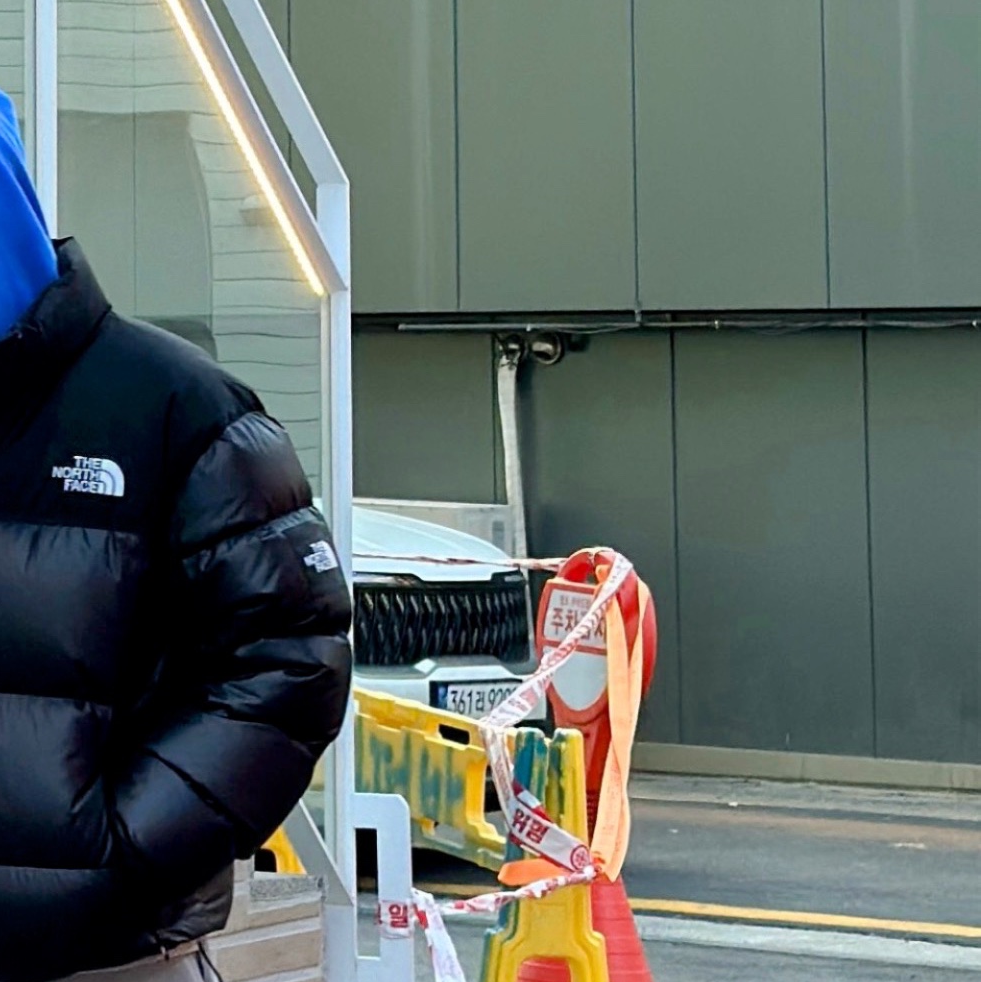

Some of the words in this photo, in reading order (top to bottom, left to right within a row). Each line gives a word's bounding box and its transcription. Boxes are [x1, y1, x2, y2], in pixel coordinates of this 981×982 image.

[73, 456, 102, 469] THE
[52, 466, 101, 481] NORTH
[64, 479, 99, 494] FACE
[512, 808, 550, 844] 위험
